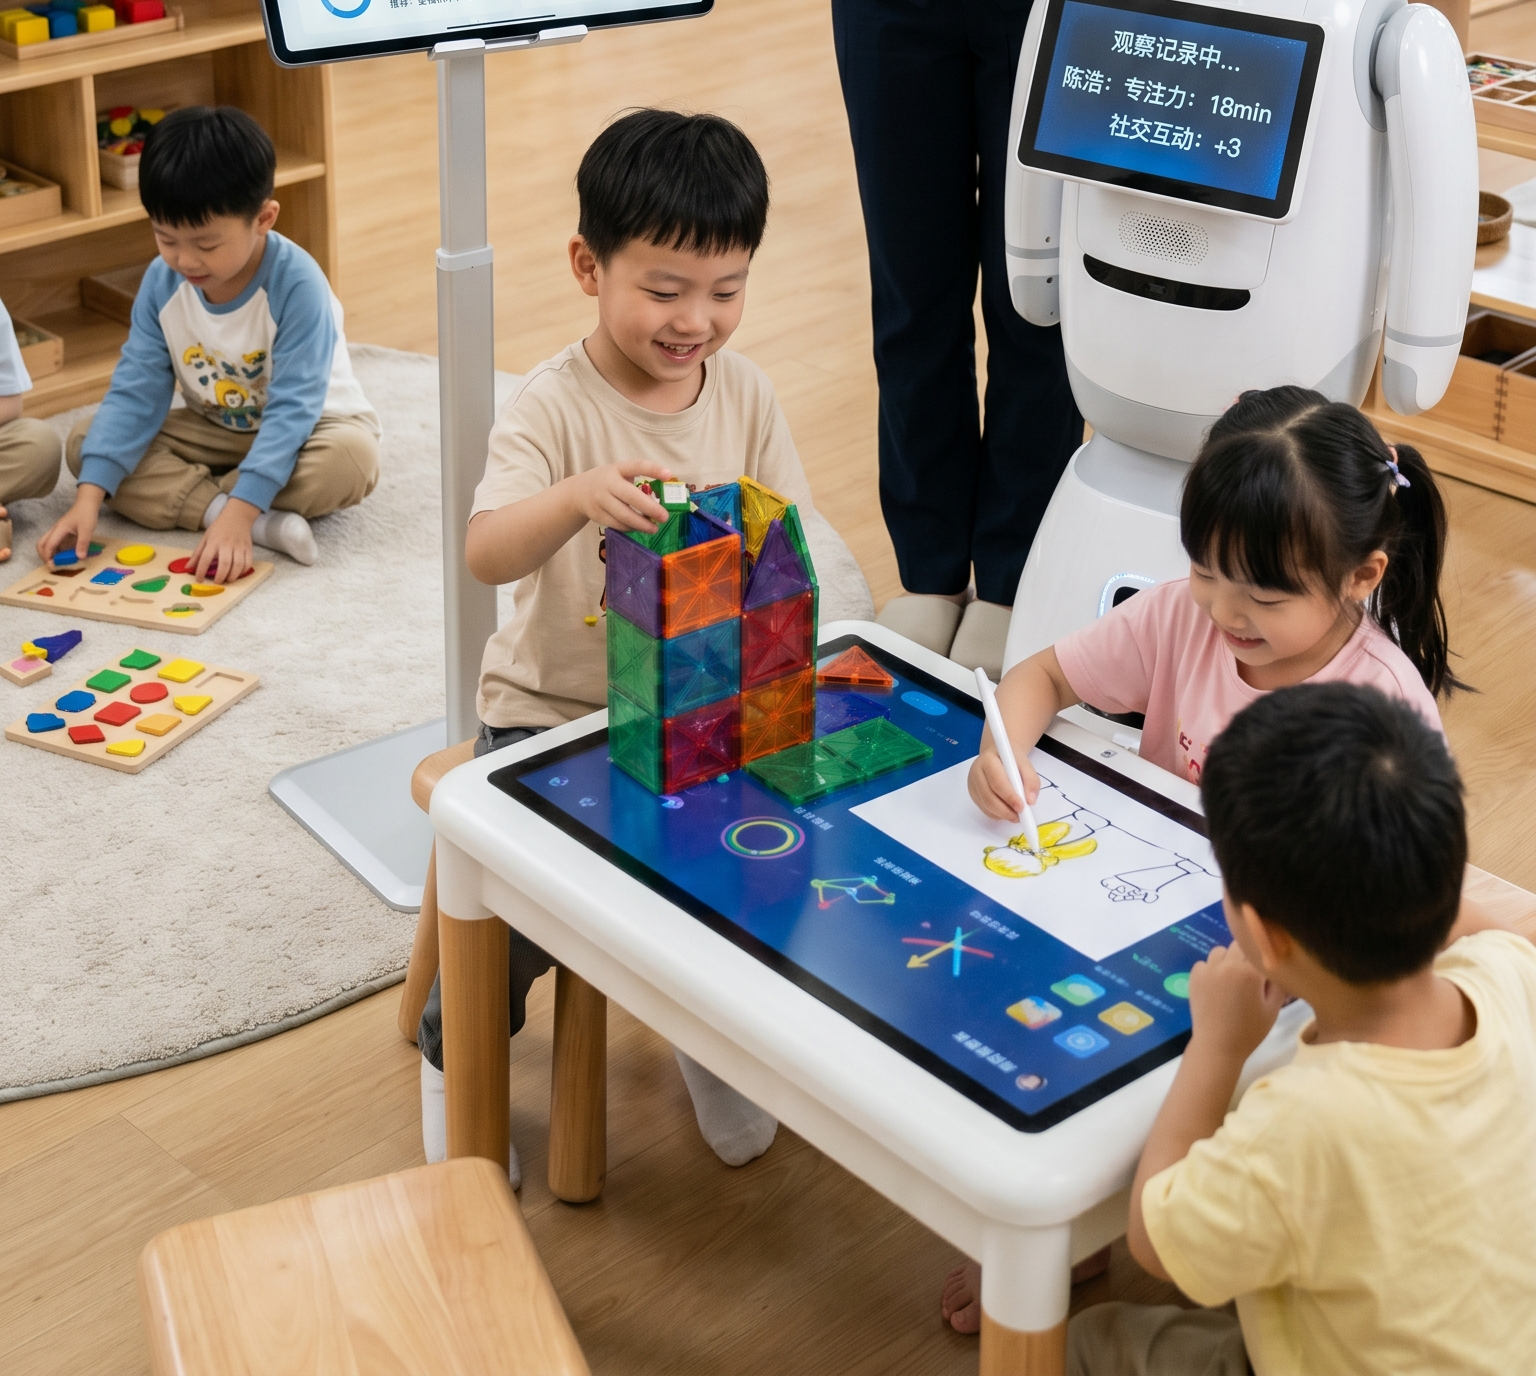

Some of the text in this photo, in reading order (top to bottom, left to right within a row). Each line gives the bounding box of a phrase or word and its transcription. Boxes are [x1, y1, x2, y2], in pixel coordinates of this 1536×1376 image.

[1111, 30, 1241, 73] 观察记录中...
